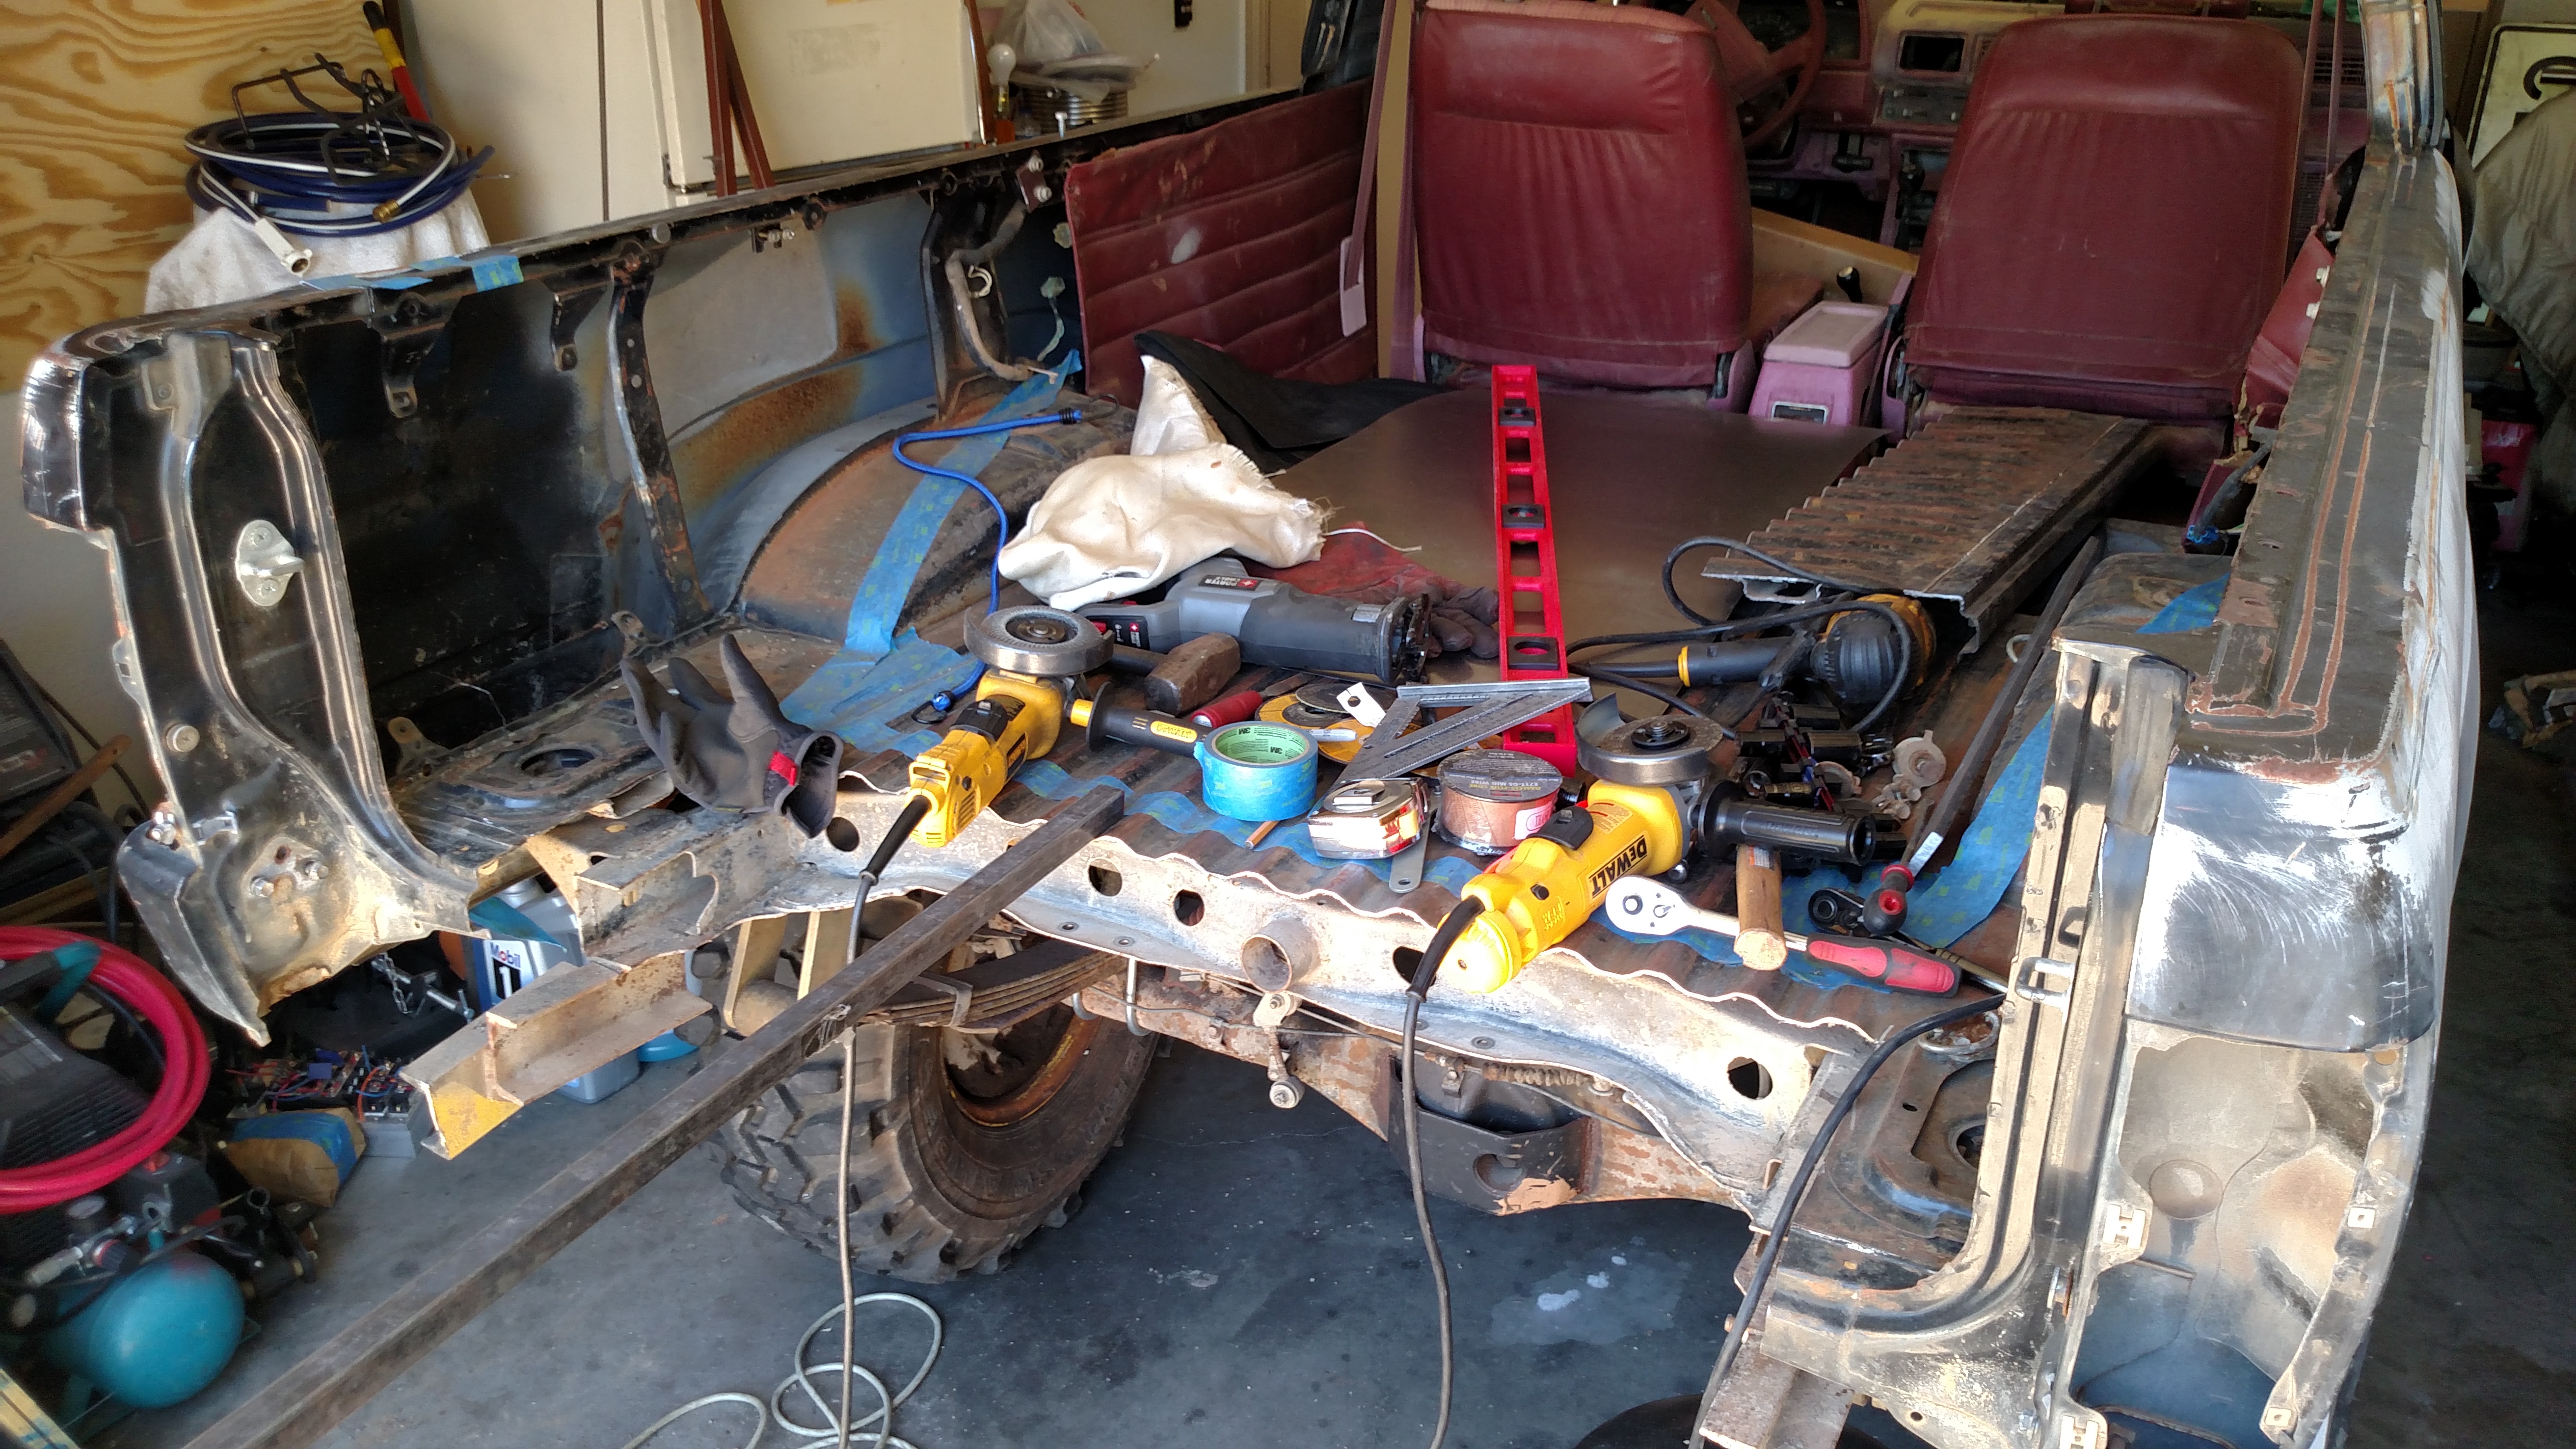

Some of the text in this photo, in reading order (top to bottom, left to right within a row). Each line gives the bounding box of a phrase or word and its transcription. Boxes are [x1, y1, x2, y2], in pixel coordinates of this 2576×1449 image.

[1270, 746, 1283, 754] 3M
[490, 942, 521, 968] Mobil
[499, 966, 512, 998] 1
